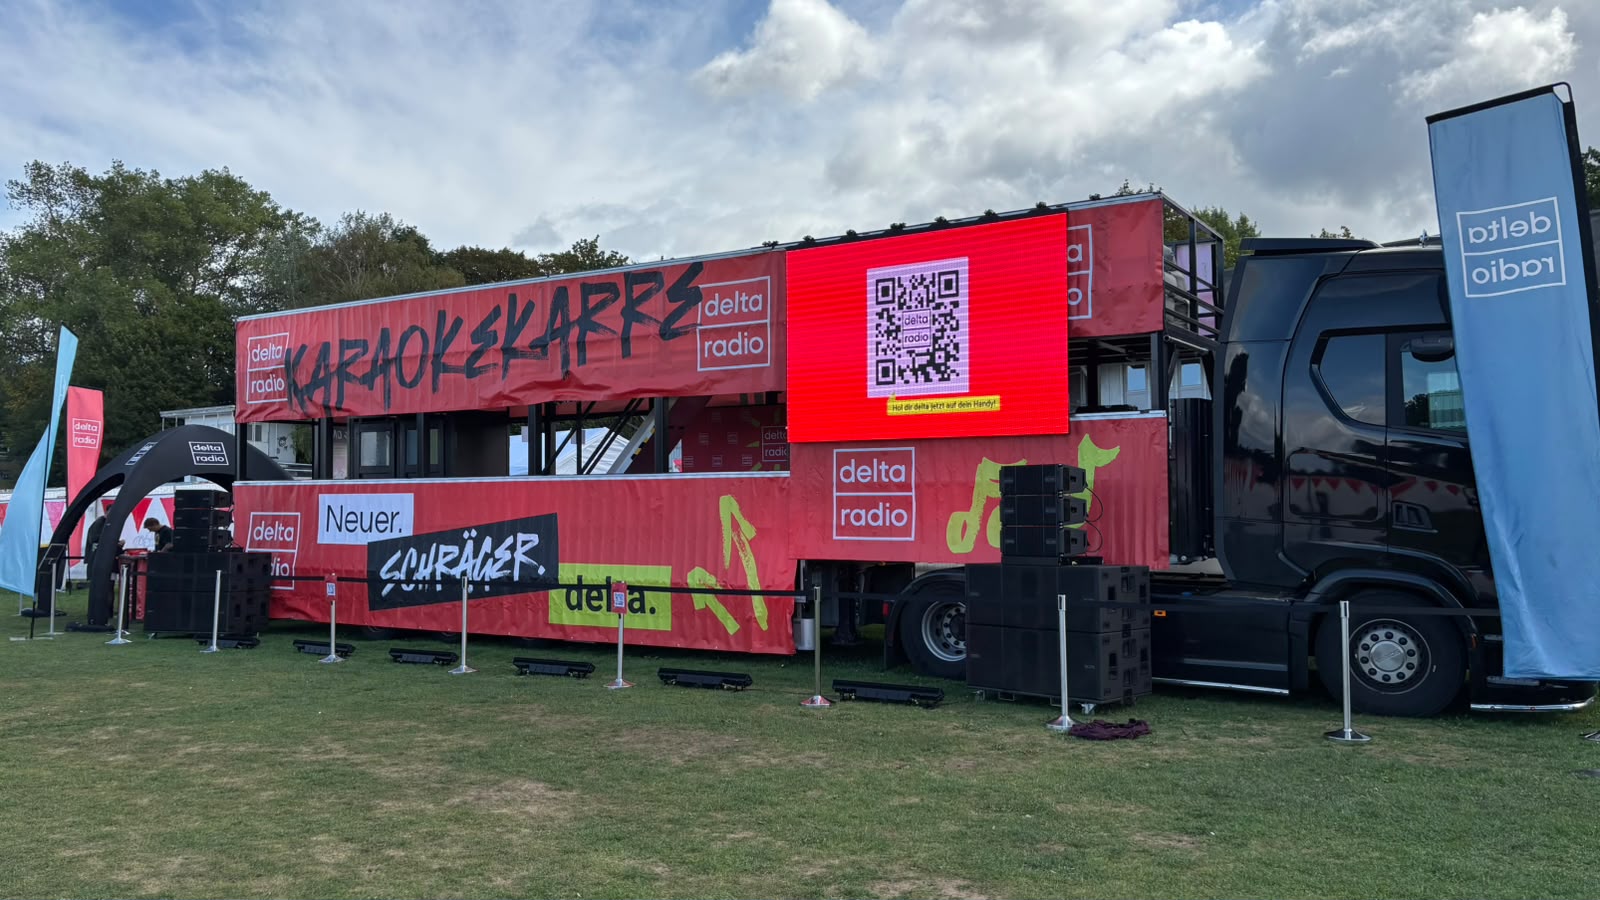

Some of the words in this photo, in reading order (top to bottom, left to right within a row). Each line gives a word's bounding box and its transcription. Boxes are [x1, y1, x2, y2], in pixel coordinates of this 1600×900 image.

[704, 290, 763, 317] delta
[904, 314, 929, 326] delta
[284, 261, 704, 417] KARAOKEKARRE
[704, 331, 764, 358] radio
[904, 332, 929, 343] radio
[251, 342, 283, 363] delta
[251, 373, 285, 394] radio
[892, 404, 903, 412] Hol
[914, 403, 930, 411] delta
[930, 402, 945, 411] jetzt
[946, 401, 957, 409] auf
[957, 401, 973, 409] dein
[973, 399, 996, 409] Handy!
[74, 418, 98, 432] delta
[74, 434, 97, 446] radio
[192, 443, 222, 452] delta
[195, 453, 225, 463] radio
[840, 458, 906, 483] delta
[326, 504, 403, 534] Neuer.
[841, 501, 908, 527] radio
[253, 520, 295, 543] delta
[379, 528, 546, 597] SCHRÄGER.
[565, 574, 657, 615] dela.
